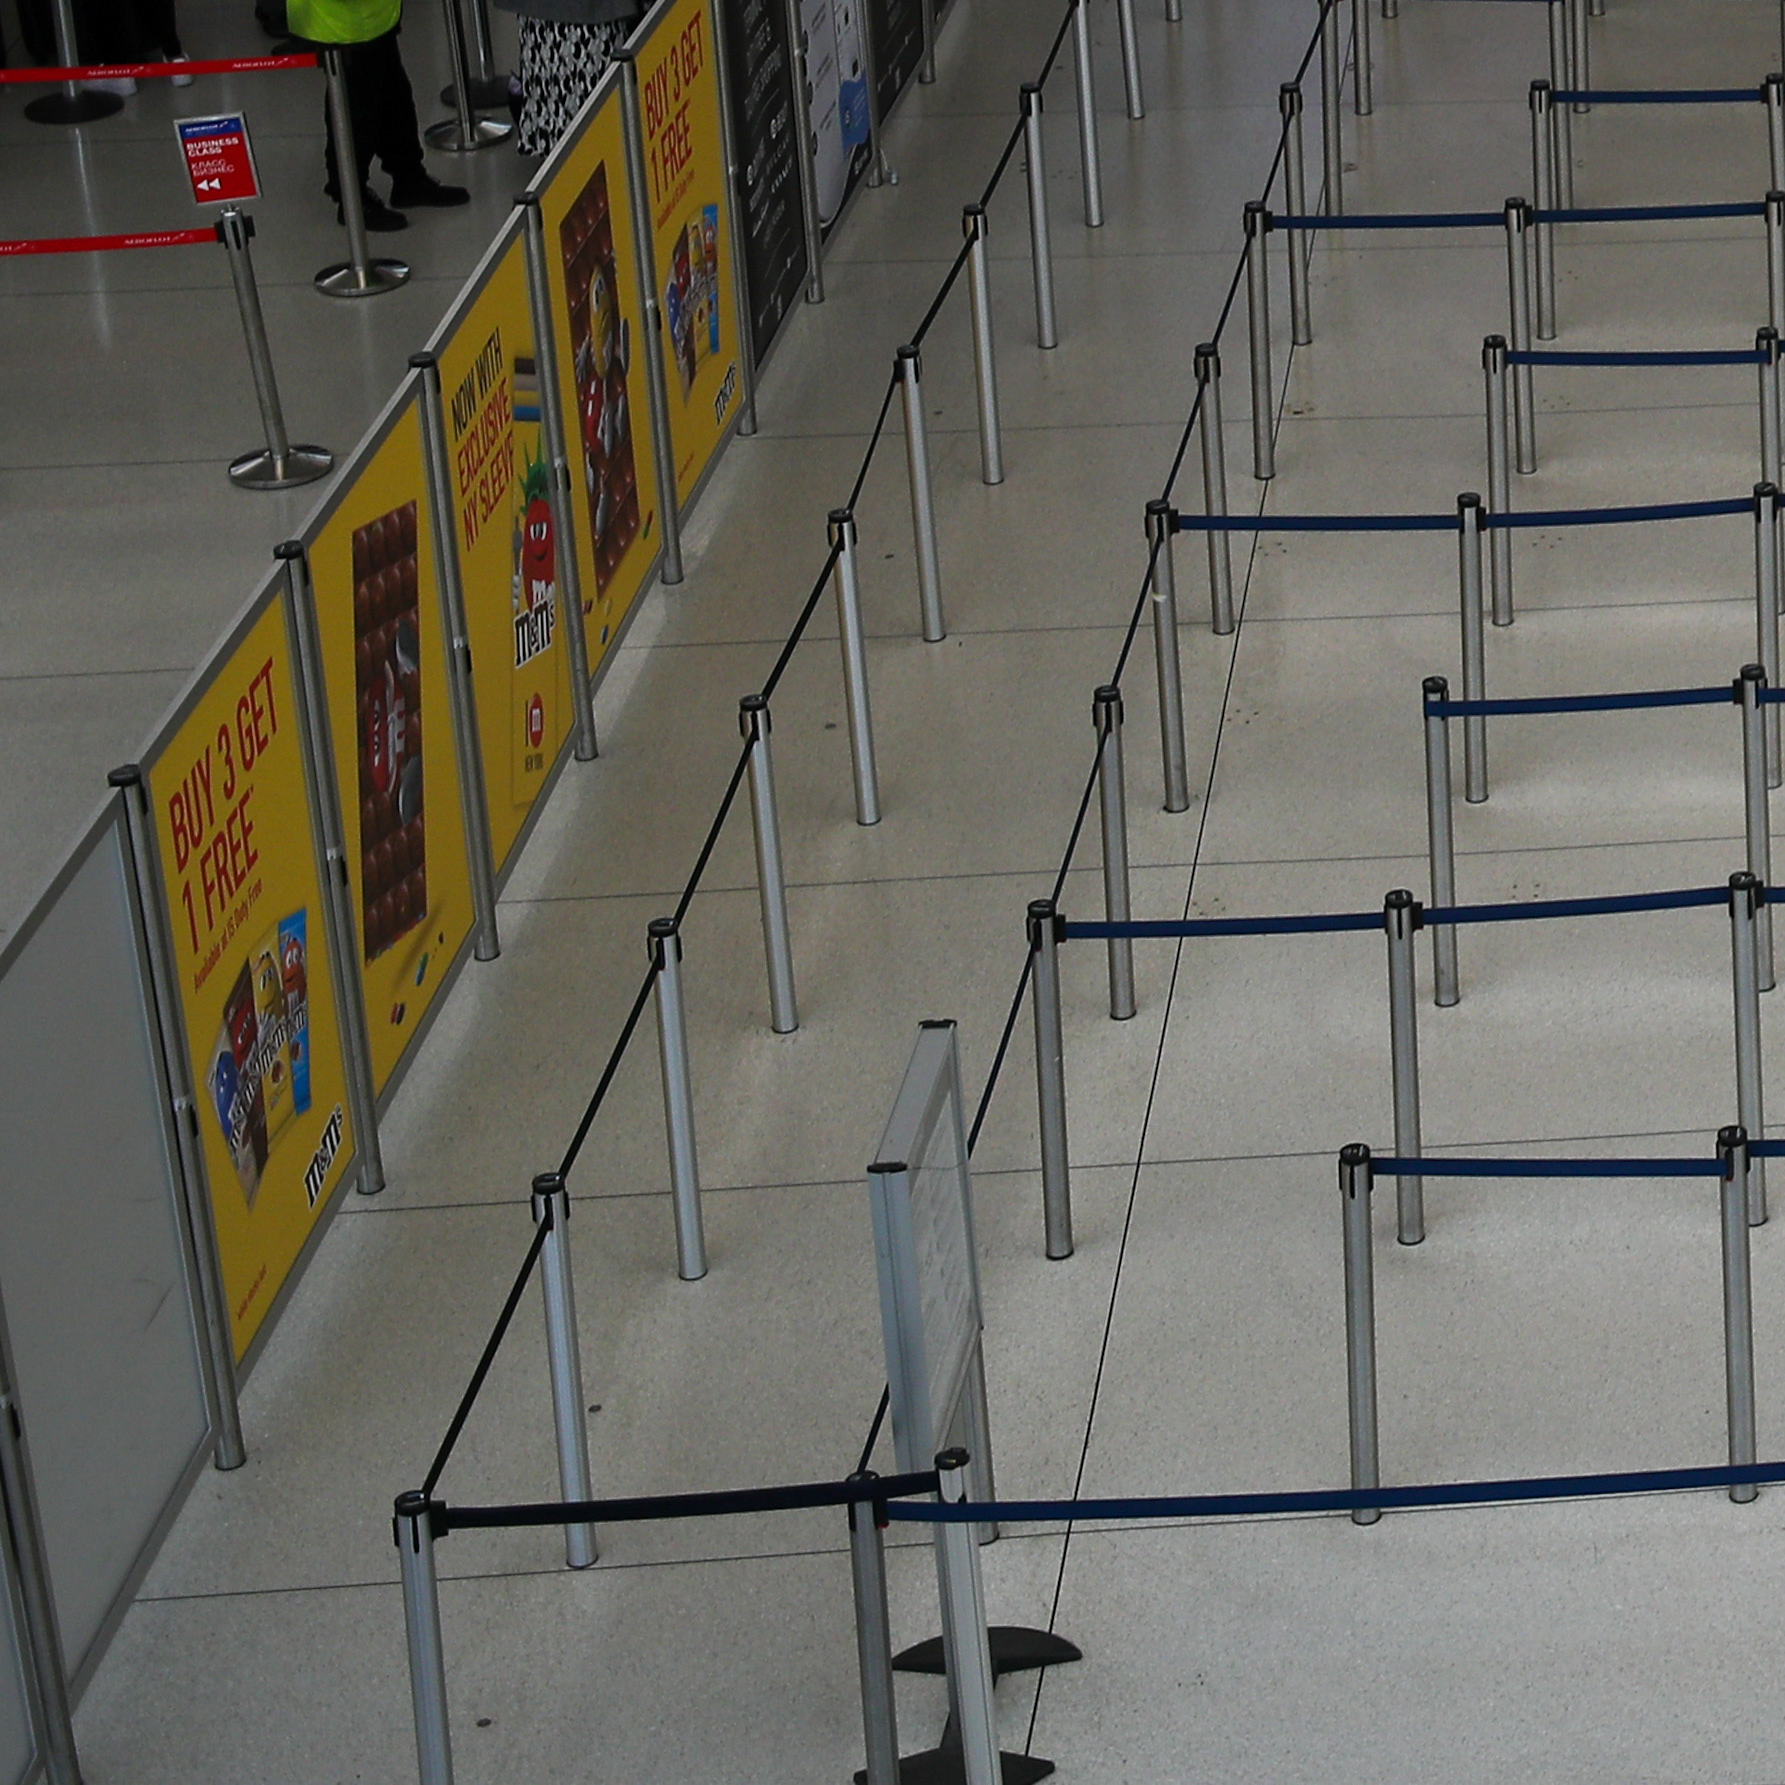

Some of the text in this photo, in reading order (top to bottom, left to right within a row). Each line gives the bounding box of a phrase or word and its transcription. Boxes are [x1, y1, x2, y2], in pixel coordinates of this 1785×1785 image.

[645, 8, 703, 141] BUY 3 GET
[186, 136, 240, 150] BUSINESS
[188, 146, 223, 158] CLASS
[651, 147, 660, 203] 1
[452, 326, 504, 442] NOW WITH
[458, 376, 512, 497] EXCLUSIVE
[463, 429, 514, 552] NY SLEEVE
[169, 656, 278, 875] BUY 3 GET
[182, 880, 199, 955] 1
